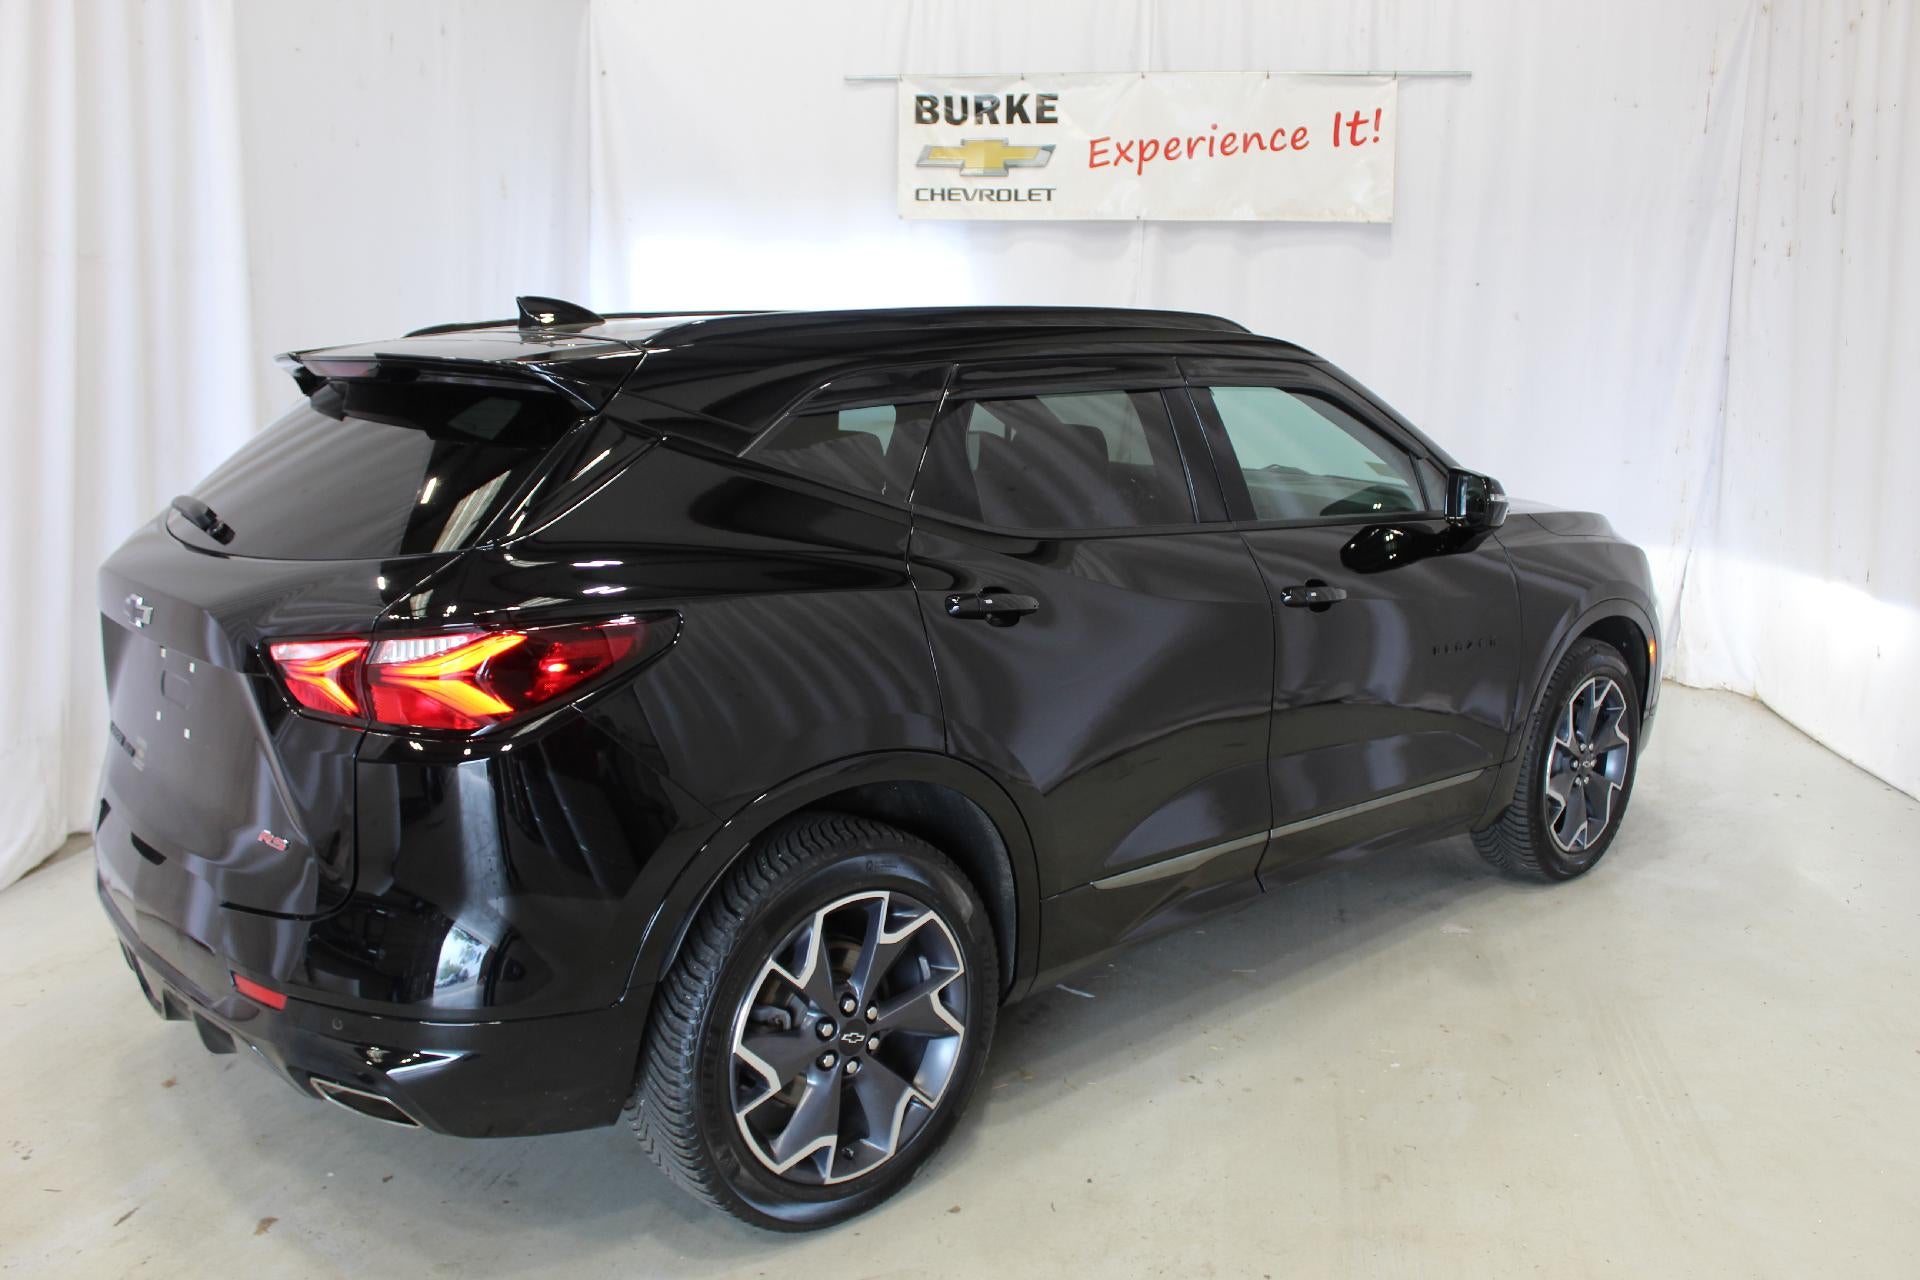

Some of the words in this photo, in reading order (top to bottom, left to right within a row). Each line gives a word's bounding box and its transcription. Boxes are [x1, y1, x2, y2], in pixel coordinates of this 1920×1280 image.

[914, 93, 1060, 126] BURKE
[1088, 124, 1310, 176] Experience
[1331, 107, 1383, 149] It!
[914, 187, 1057, 203] CHEVROLET
